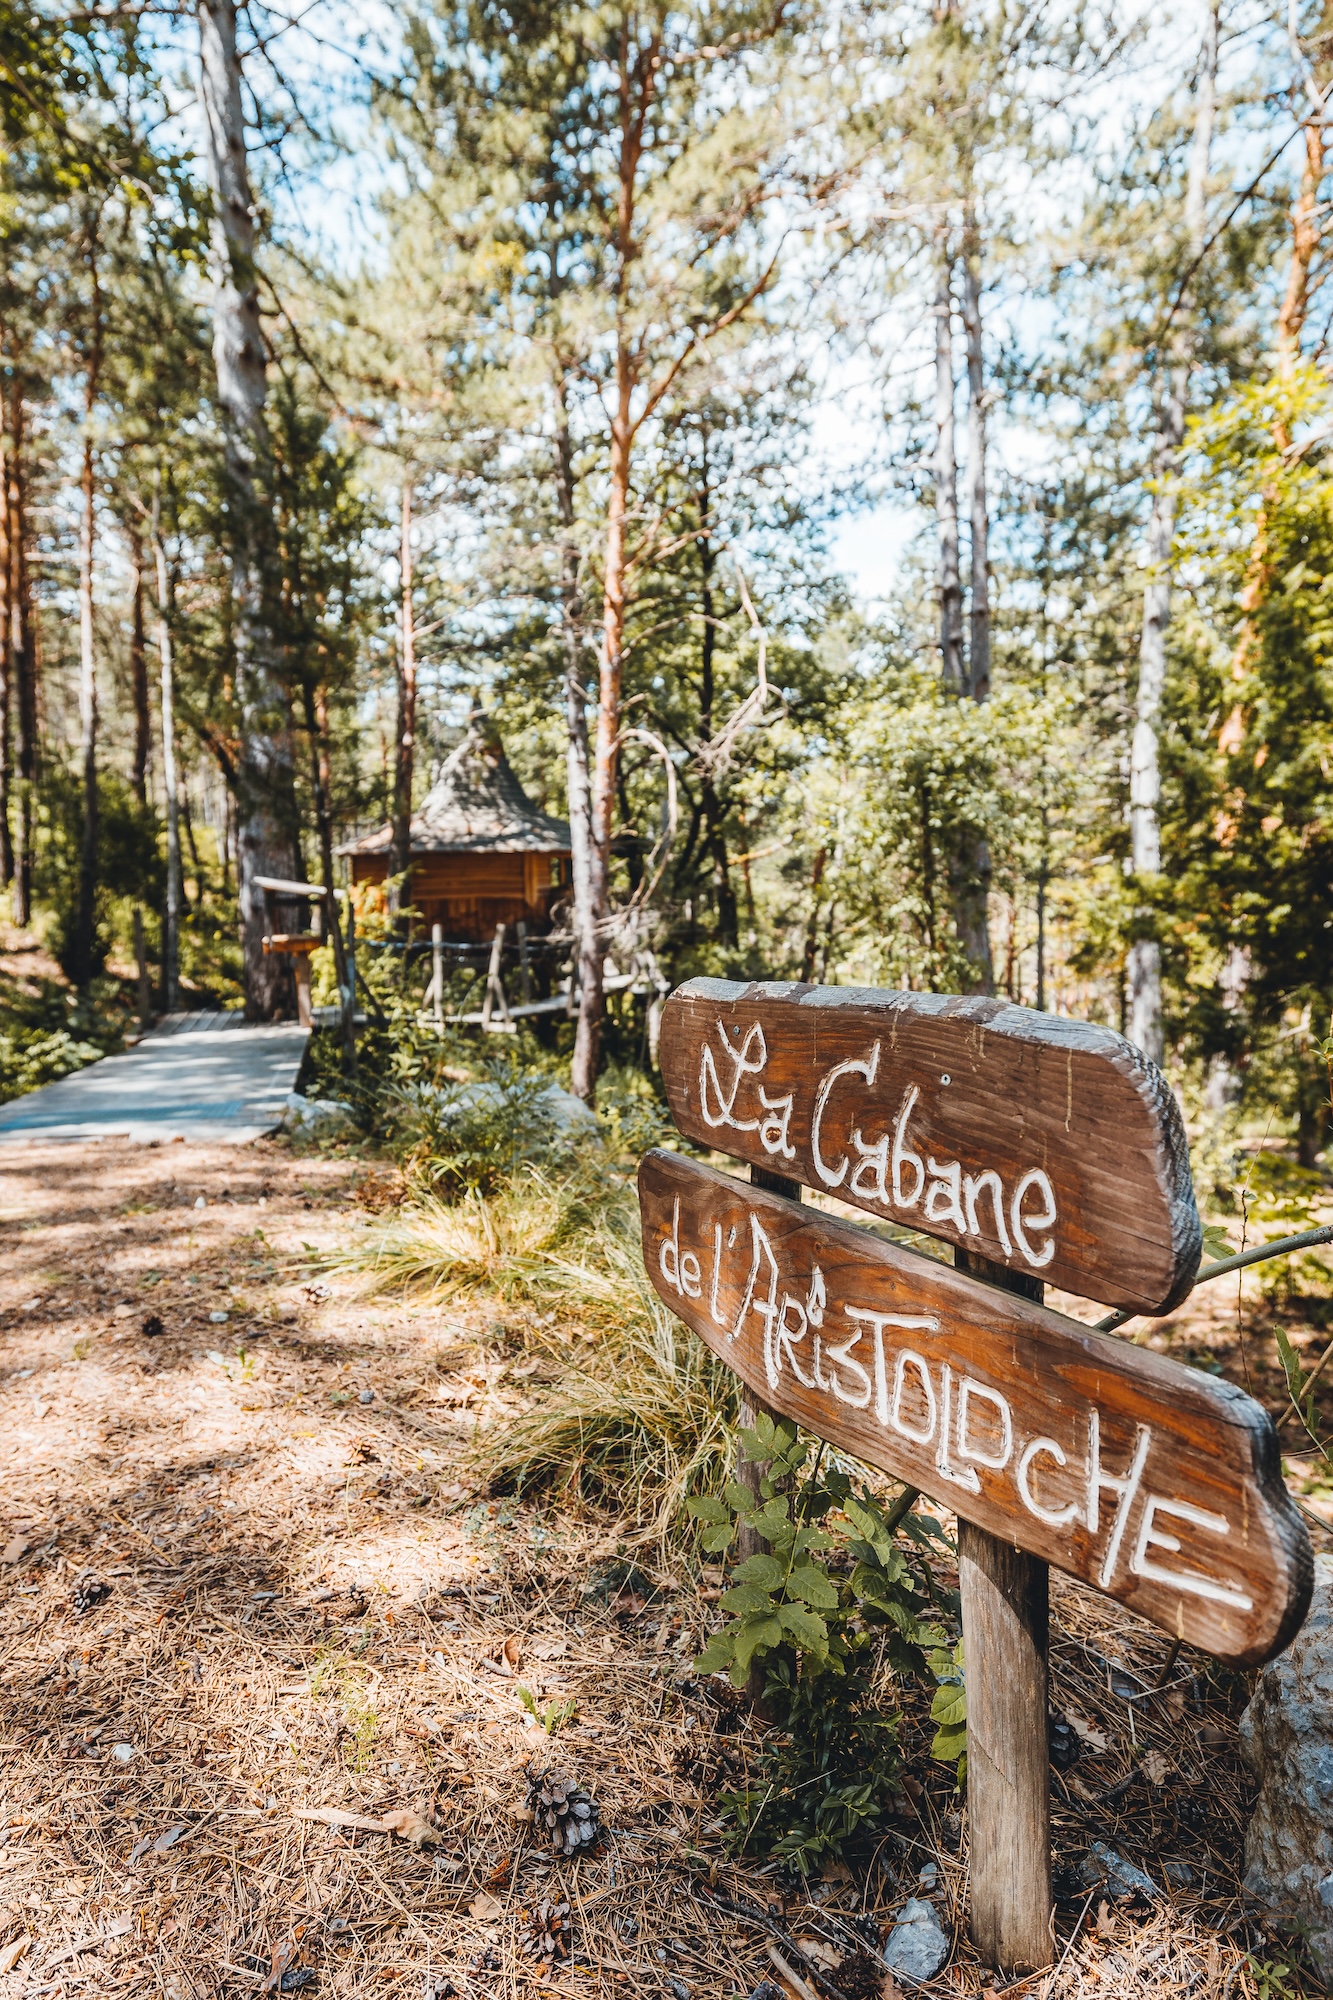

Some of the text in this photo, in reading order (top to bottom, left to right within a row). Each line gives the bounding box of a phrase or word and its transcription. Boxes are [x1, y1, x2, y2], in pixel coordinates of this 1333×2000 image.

[699, 1018, 1057, 1267] La Cabane
[659, 1193, 702, 1298] de
